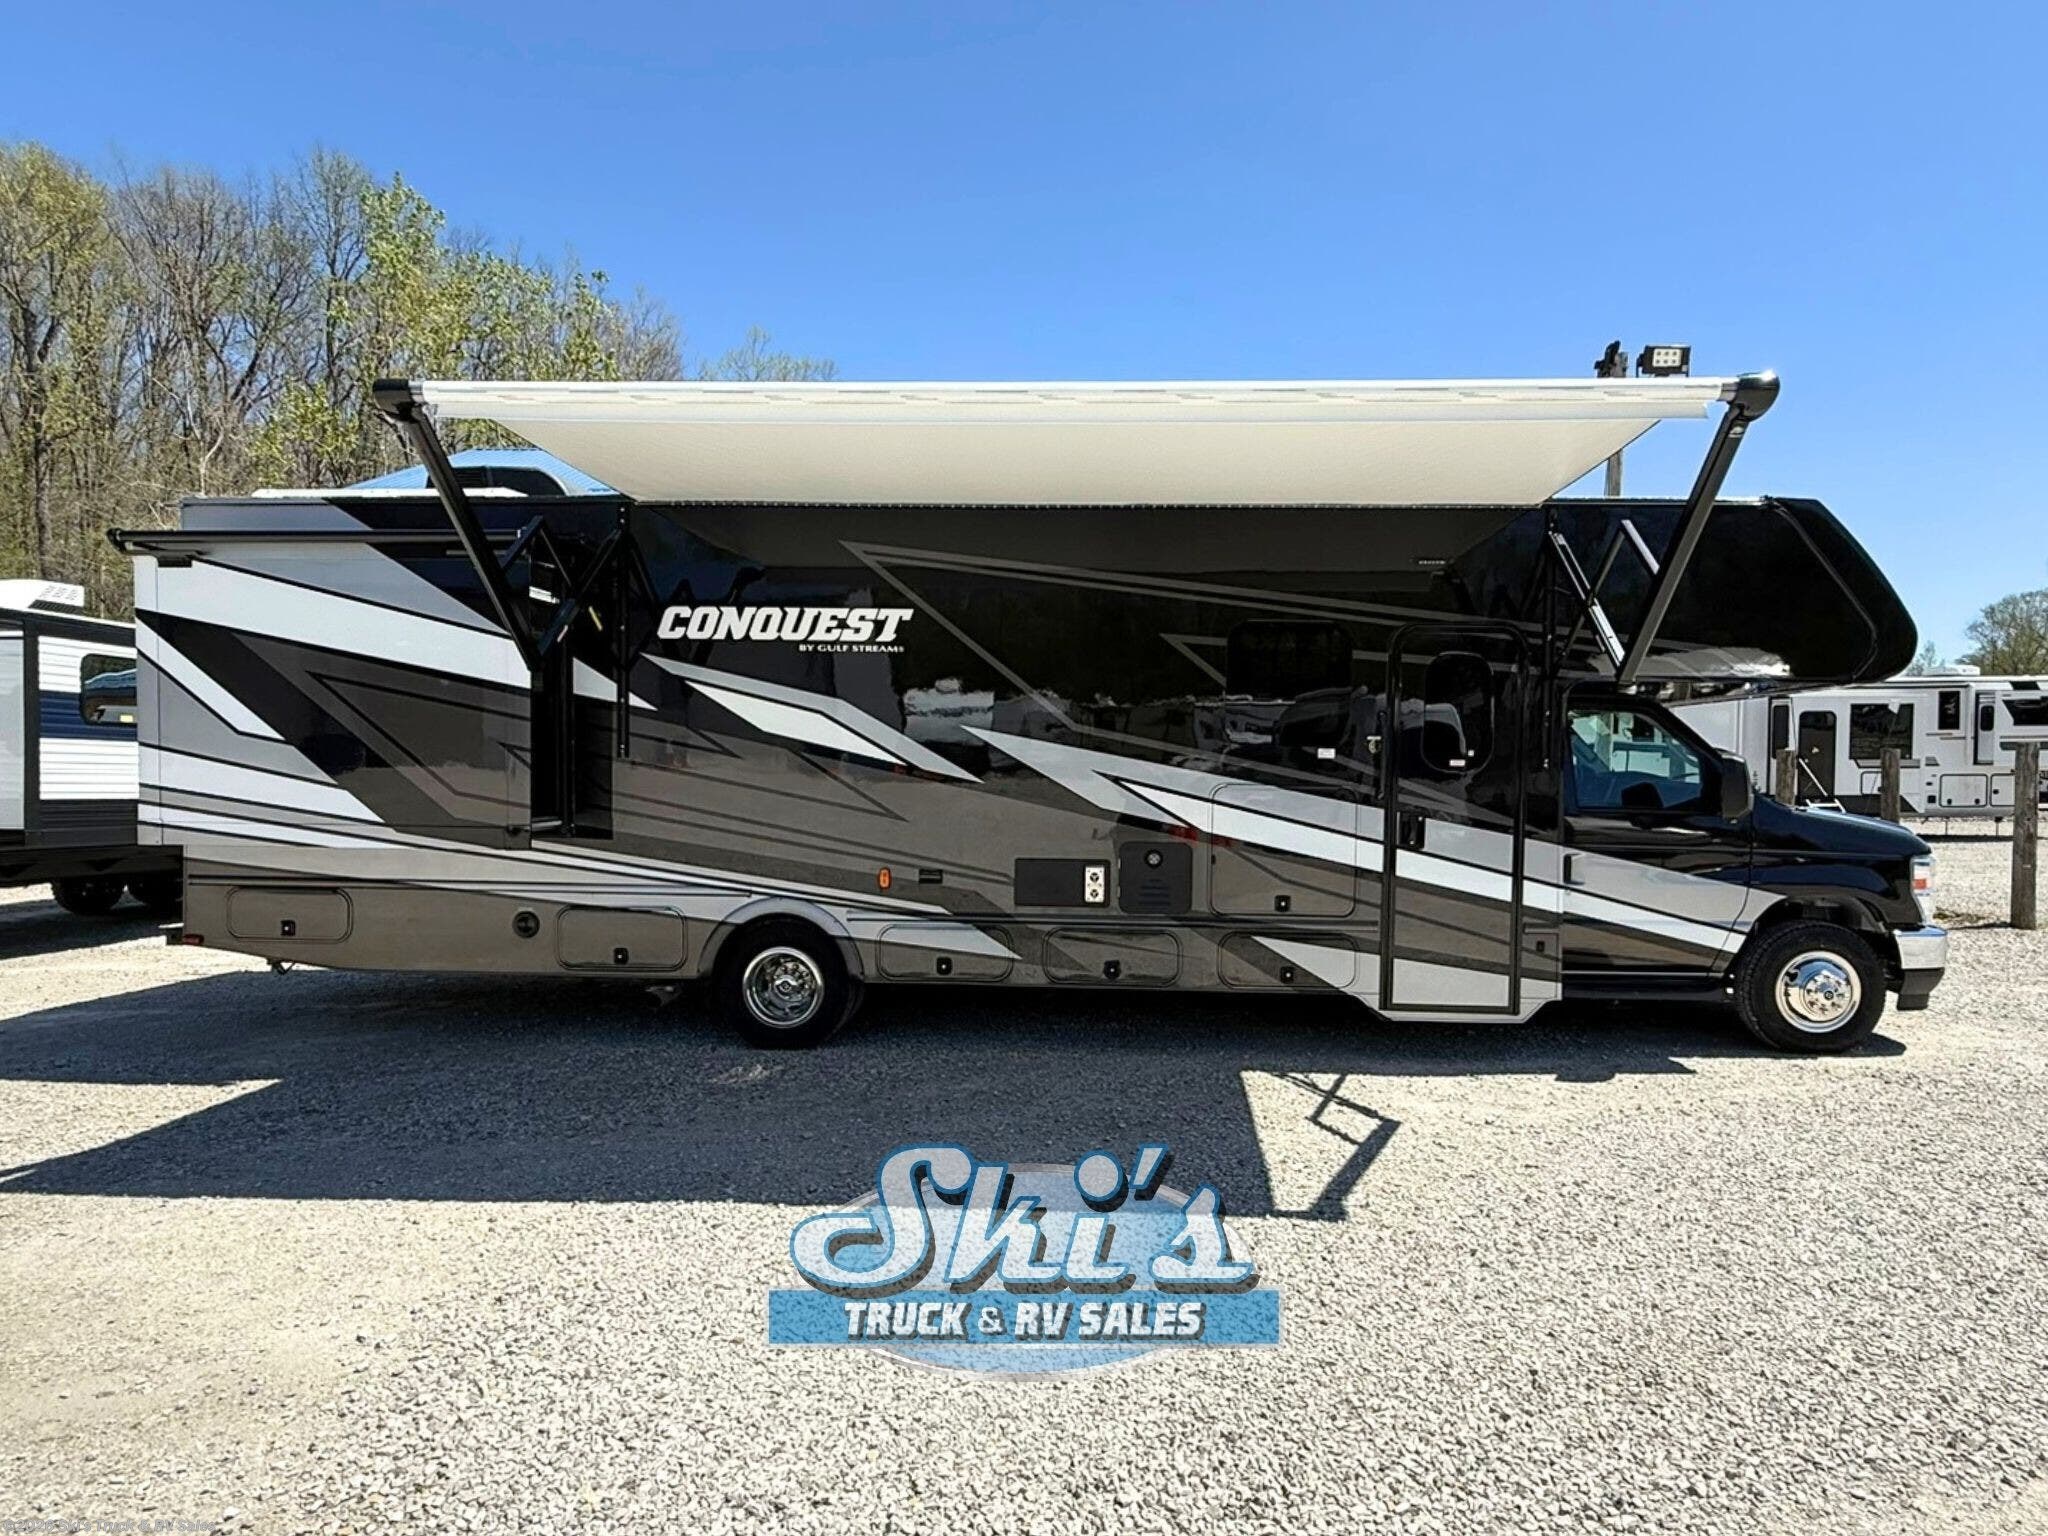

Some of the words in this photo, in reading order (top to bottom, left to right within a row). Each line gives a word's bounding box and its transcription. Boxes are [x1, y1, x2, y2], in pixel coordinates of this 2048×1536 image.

[657, 606, 914, 642] CONQUEST
[799, 644, 815, 652] BY
[817, 644, 849, 652] GULF
